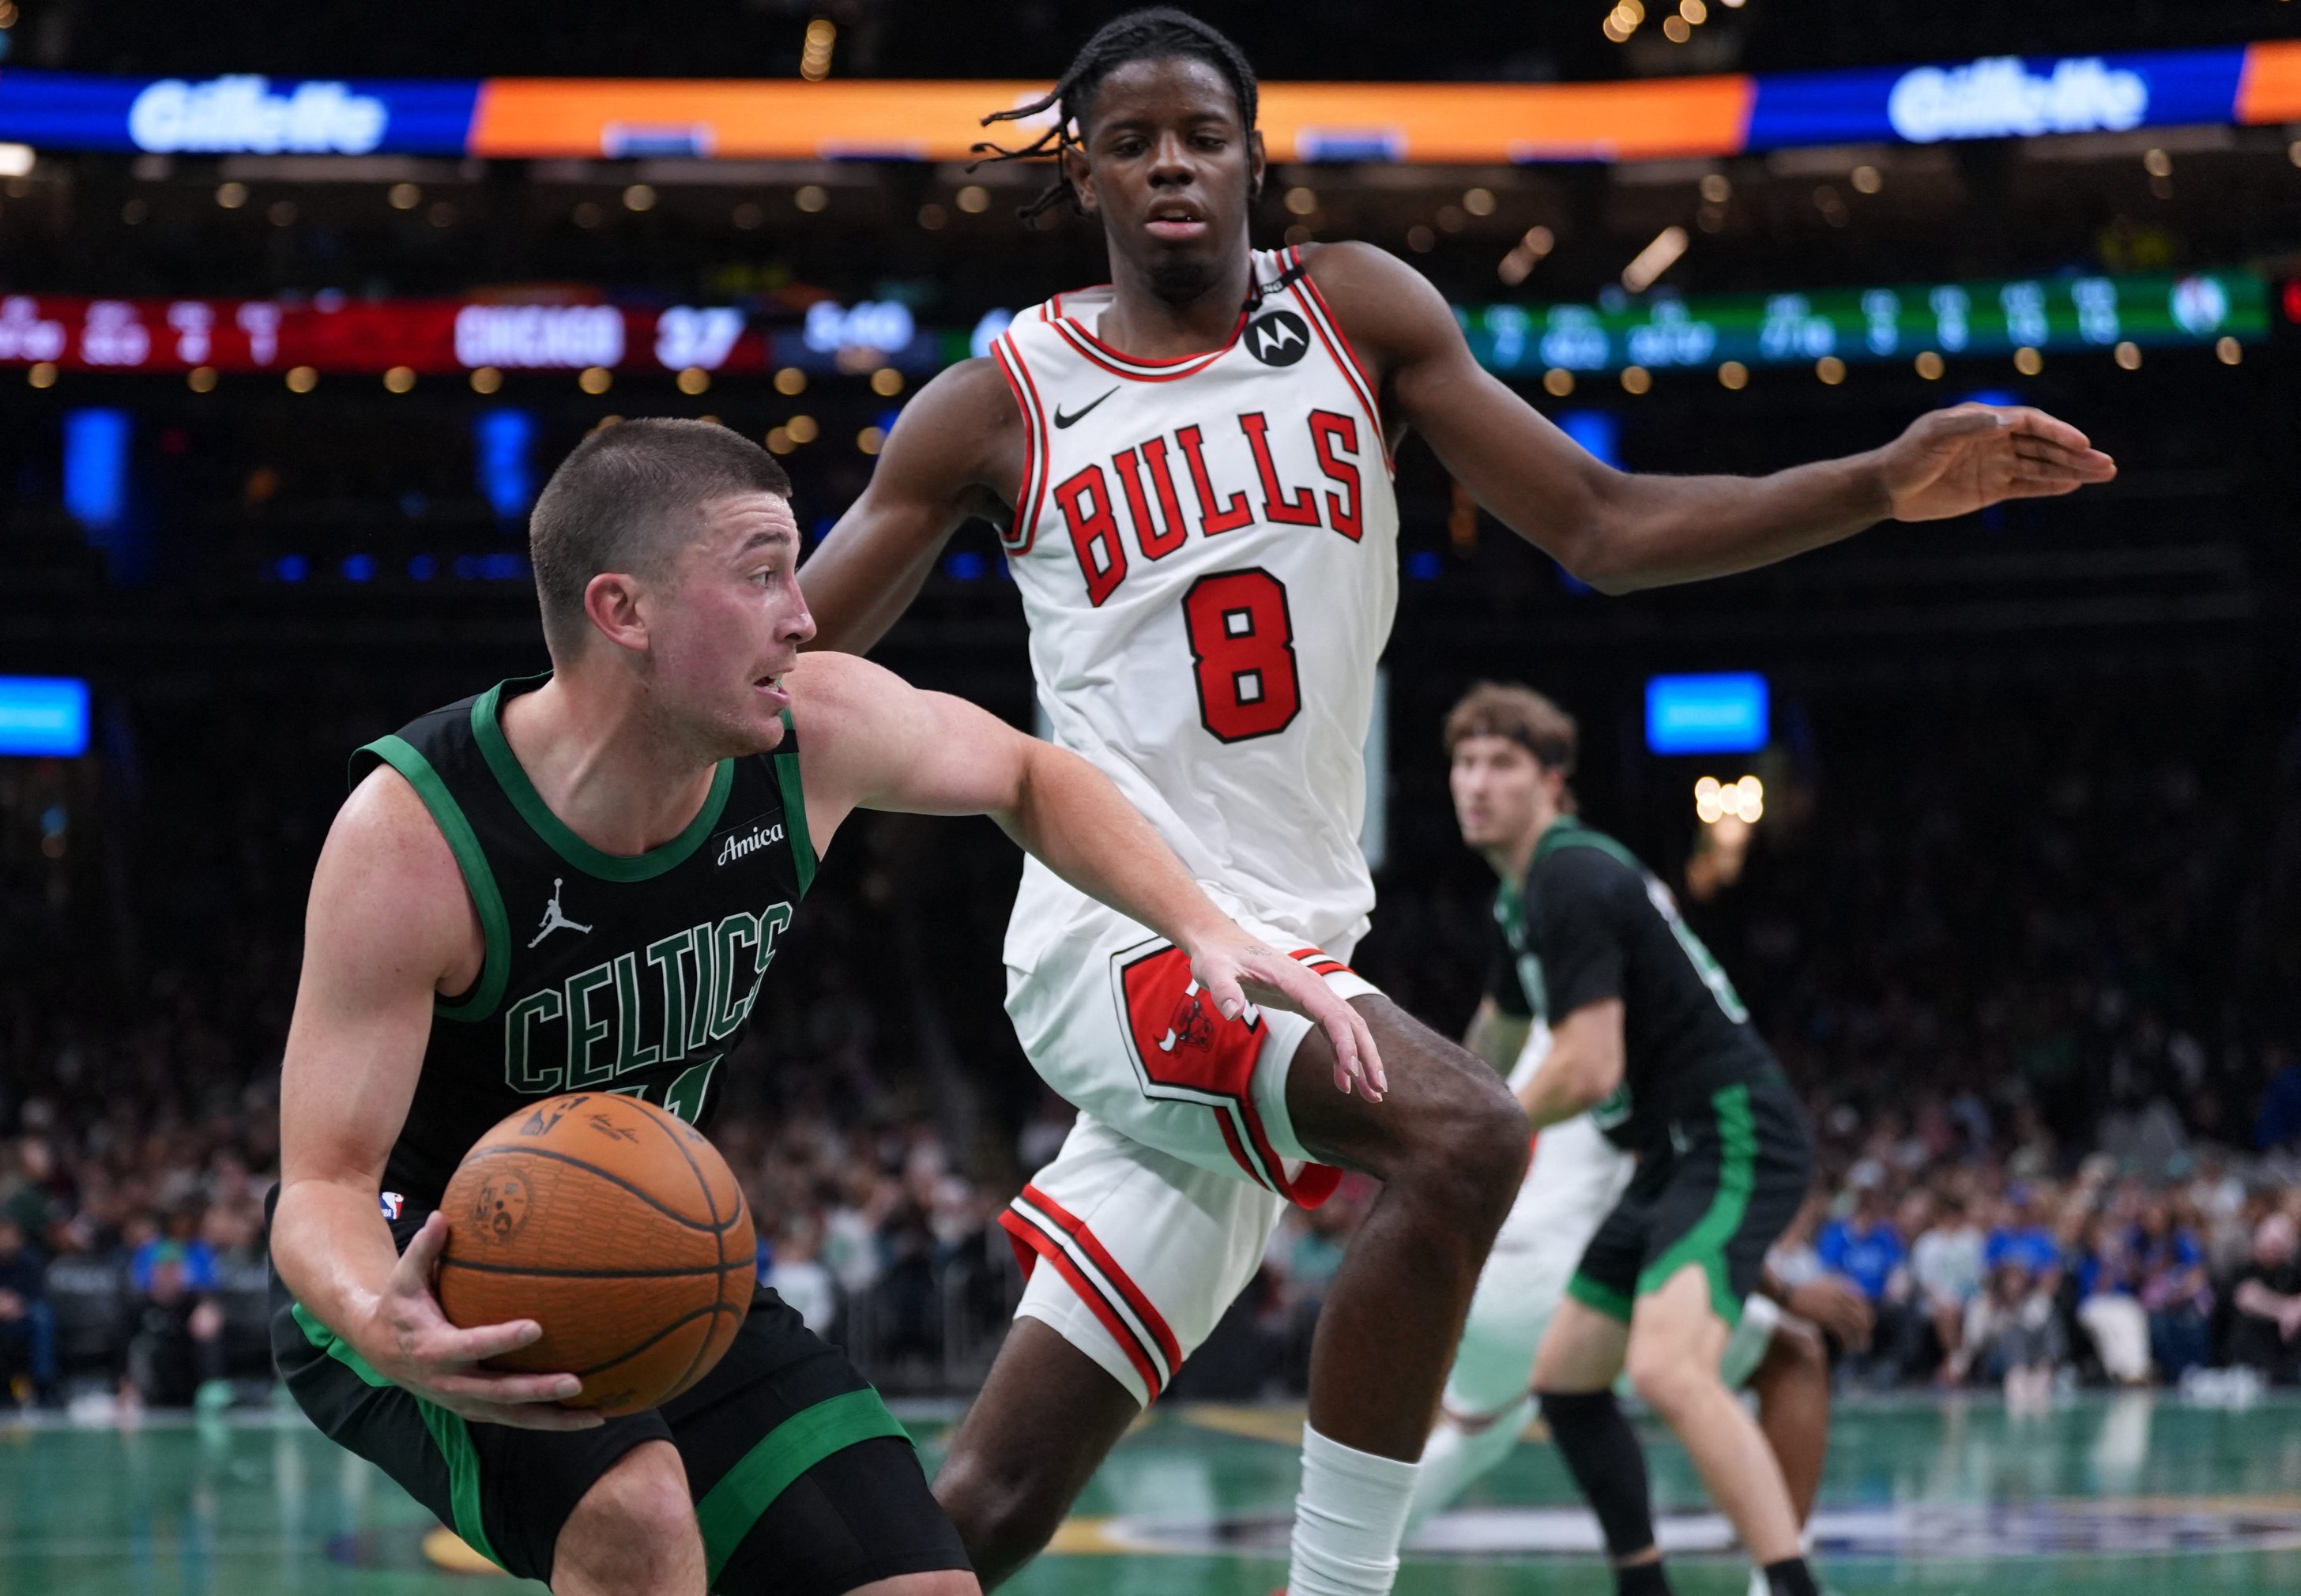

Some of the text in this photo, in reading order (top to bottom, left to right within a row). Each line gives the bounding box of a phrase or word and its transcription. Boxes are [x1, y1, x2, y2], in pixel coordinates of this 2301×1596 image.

[129, 74, 387, 155] Gillette
[1889, 55, 2147, 143] Gillette
[454, 304, 745, 371] CHICAGO 37
[1053, 408, 1363, 608] BULLS
[1181, 567, 1301, 744] 8
[717, 821, 785, 867] Amica
[504, 901, 793, 1093] CELTICS
